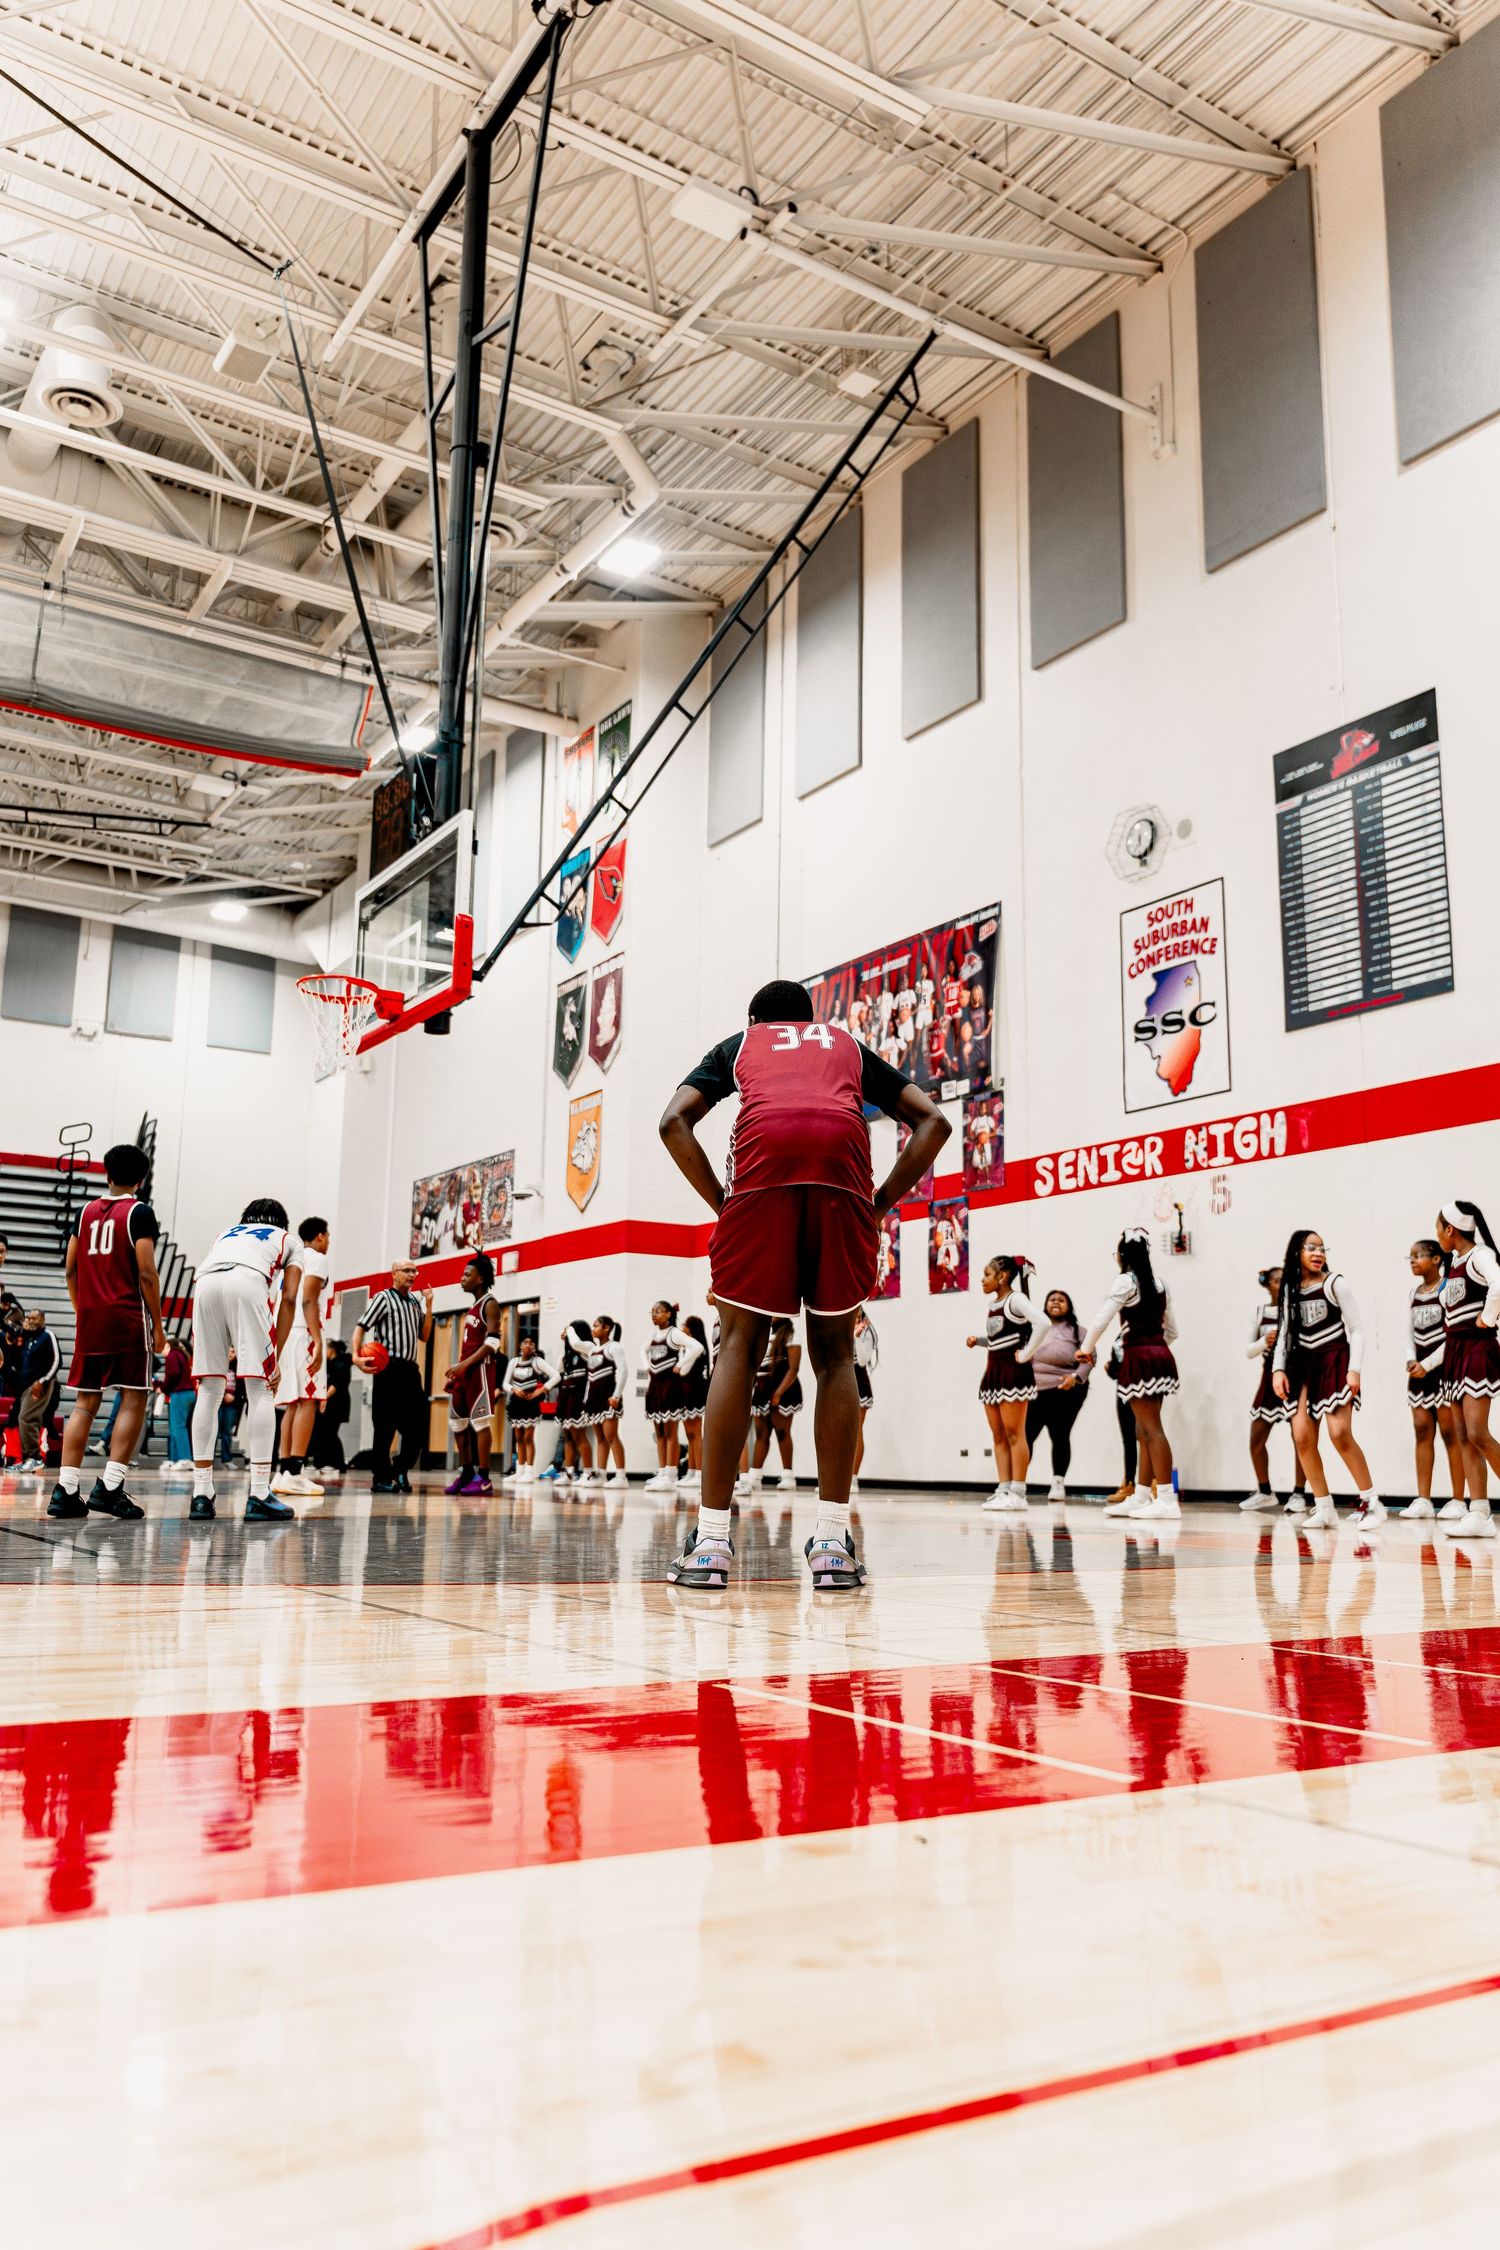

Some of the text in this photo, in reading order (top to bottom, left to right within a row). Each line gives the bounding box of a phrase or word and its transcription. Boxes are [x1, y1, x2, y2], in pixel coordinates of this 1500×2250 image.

[1146, 897, 1195, 928] SOUTH
[1133, 916, 1210, 957] SUBURBAN
[1127, 937, 1218, 980] CONFERENCE
[767, 1023, 835, 1052] 34
[1133, 1001, 1218, 1044] SSC
[1033, 1135, 1164, 1198] SENIOR
[88, 1219, 115, 1256] 10
[220, 1226, 276, 1241] 24
